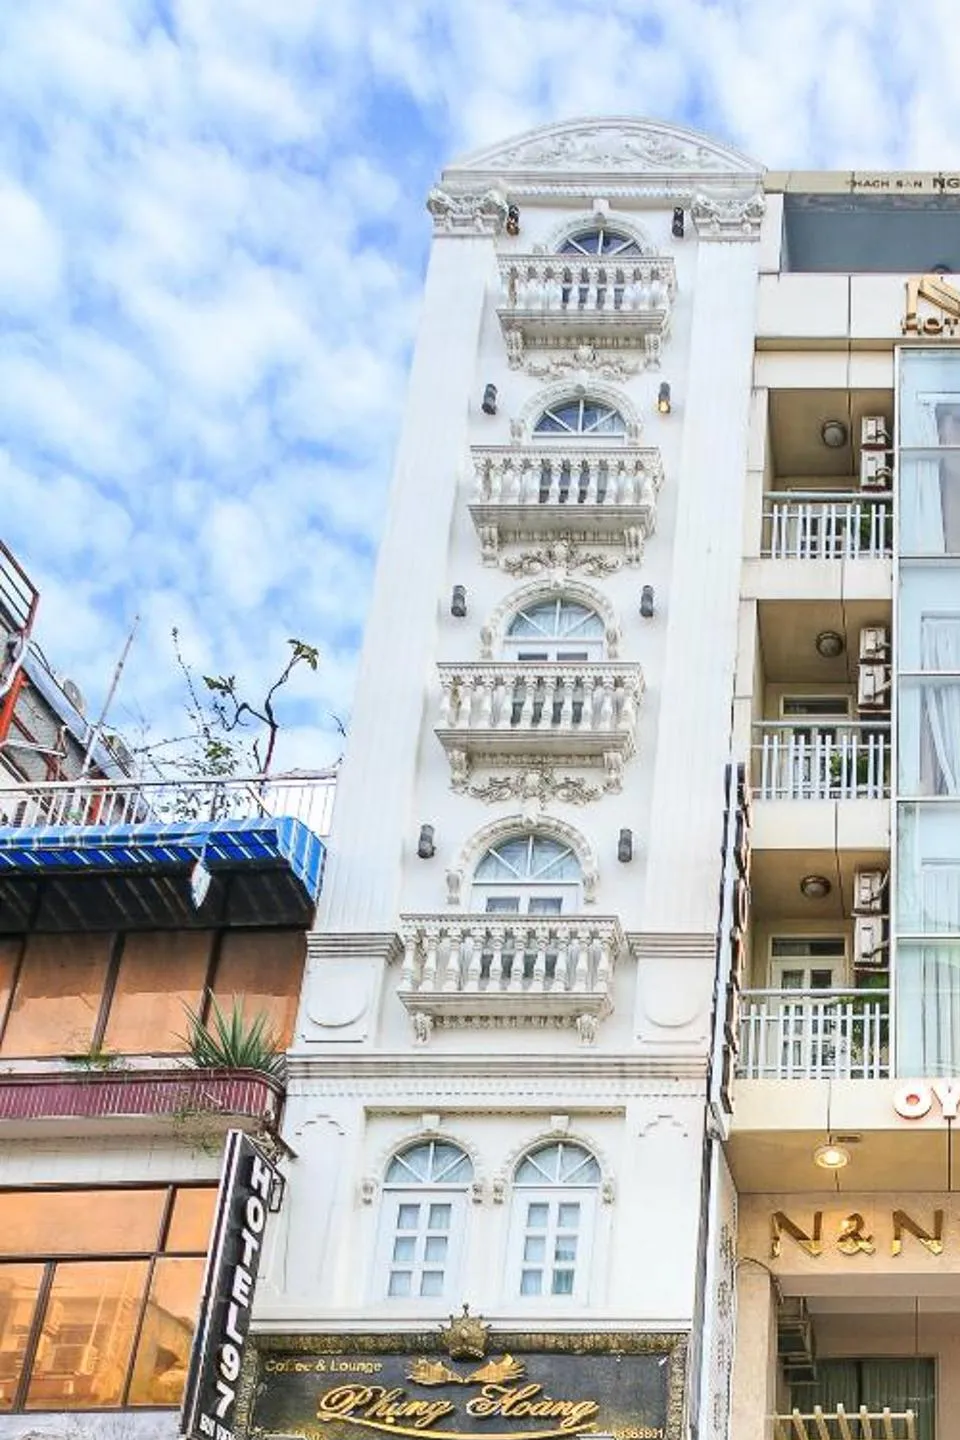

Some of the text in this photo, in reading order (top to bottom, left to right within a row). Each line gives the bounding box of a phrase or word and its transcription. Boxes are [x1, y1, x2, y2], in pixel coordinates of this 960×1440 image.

[225, 1155, 271, 1345] HOTEL
[216, 1343, 241, 1418] 97
[315, 1359, 327, 1372] &
[330, 1359, 383, 1374] Lounge
